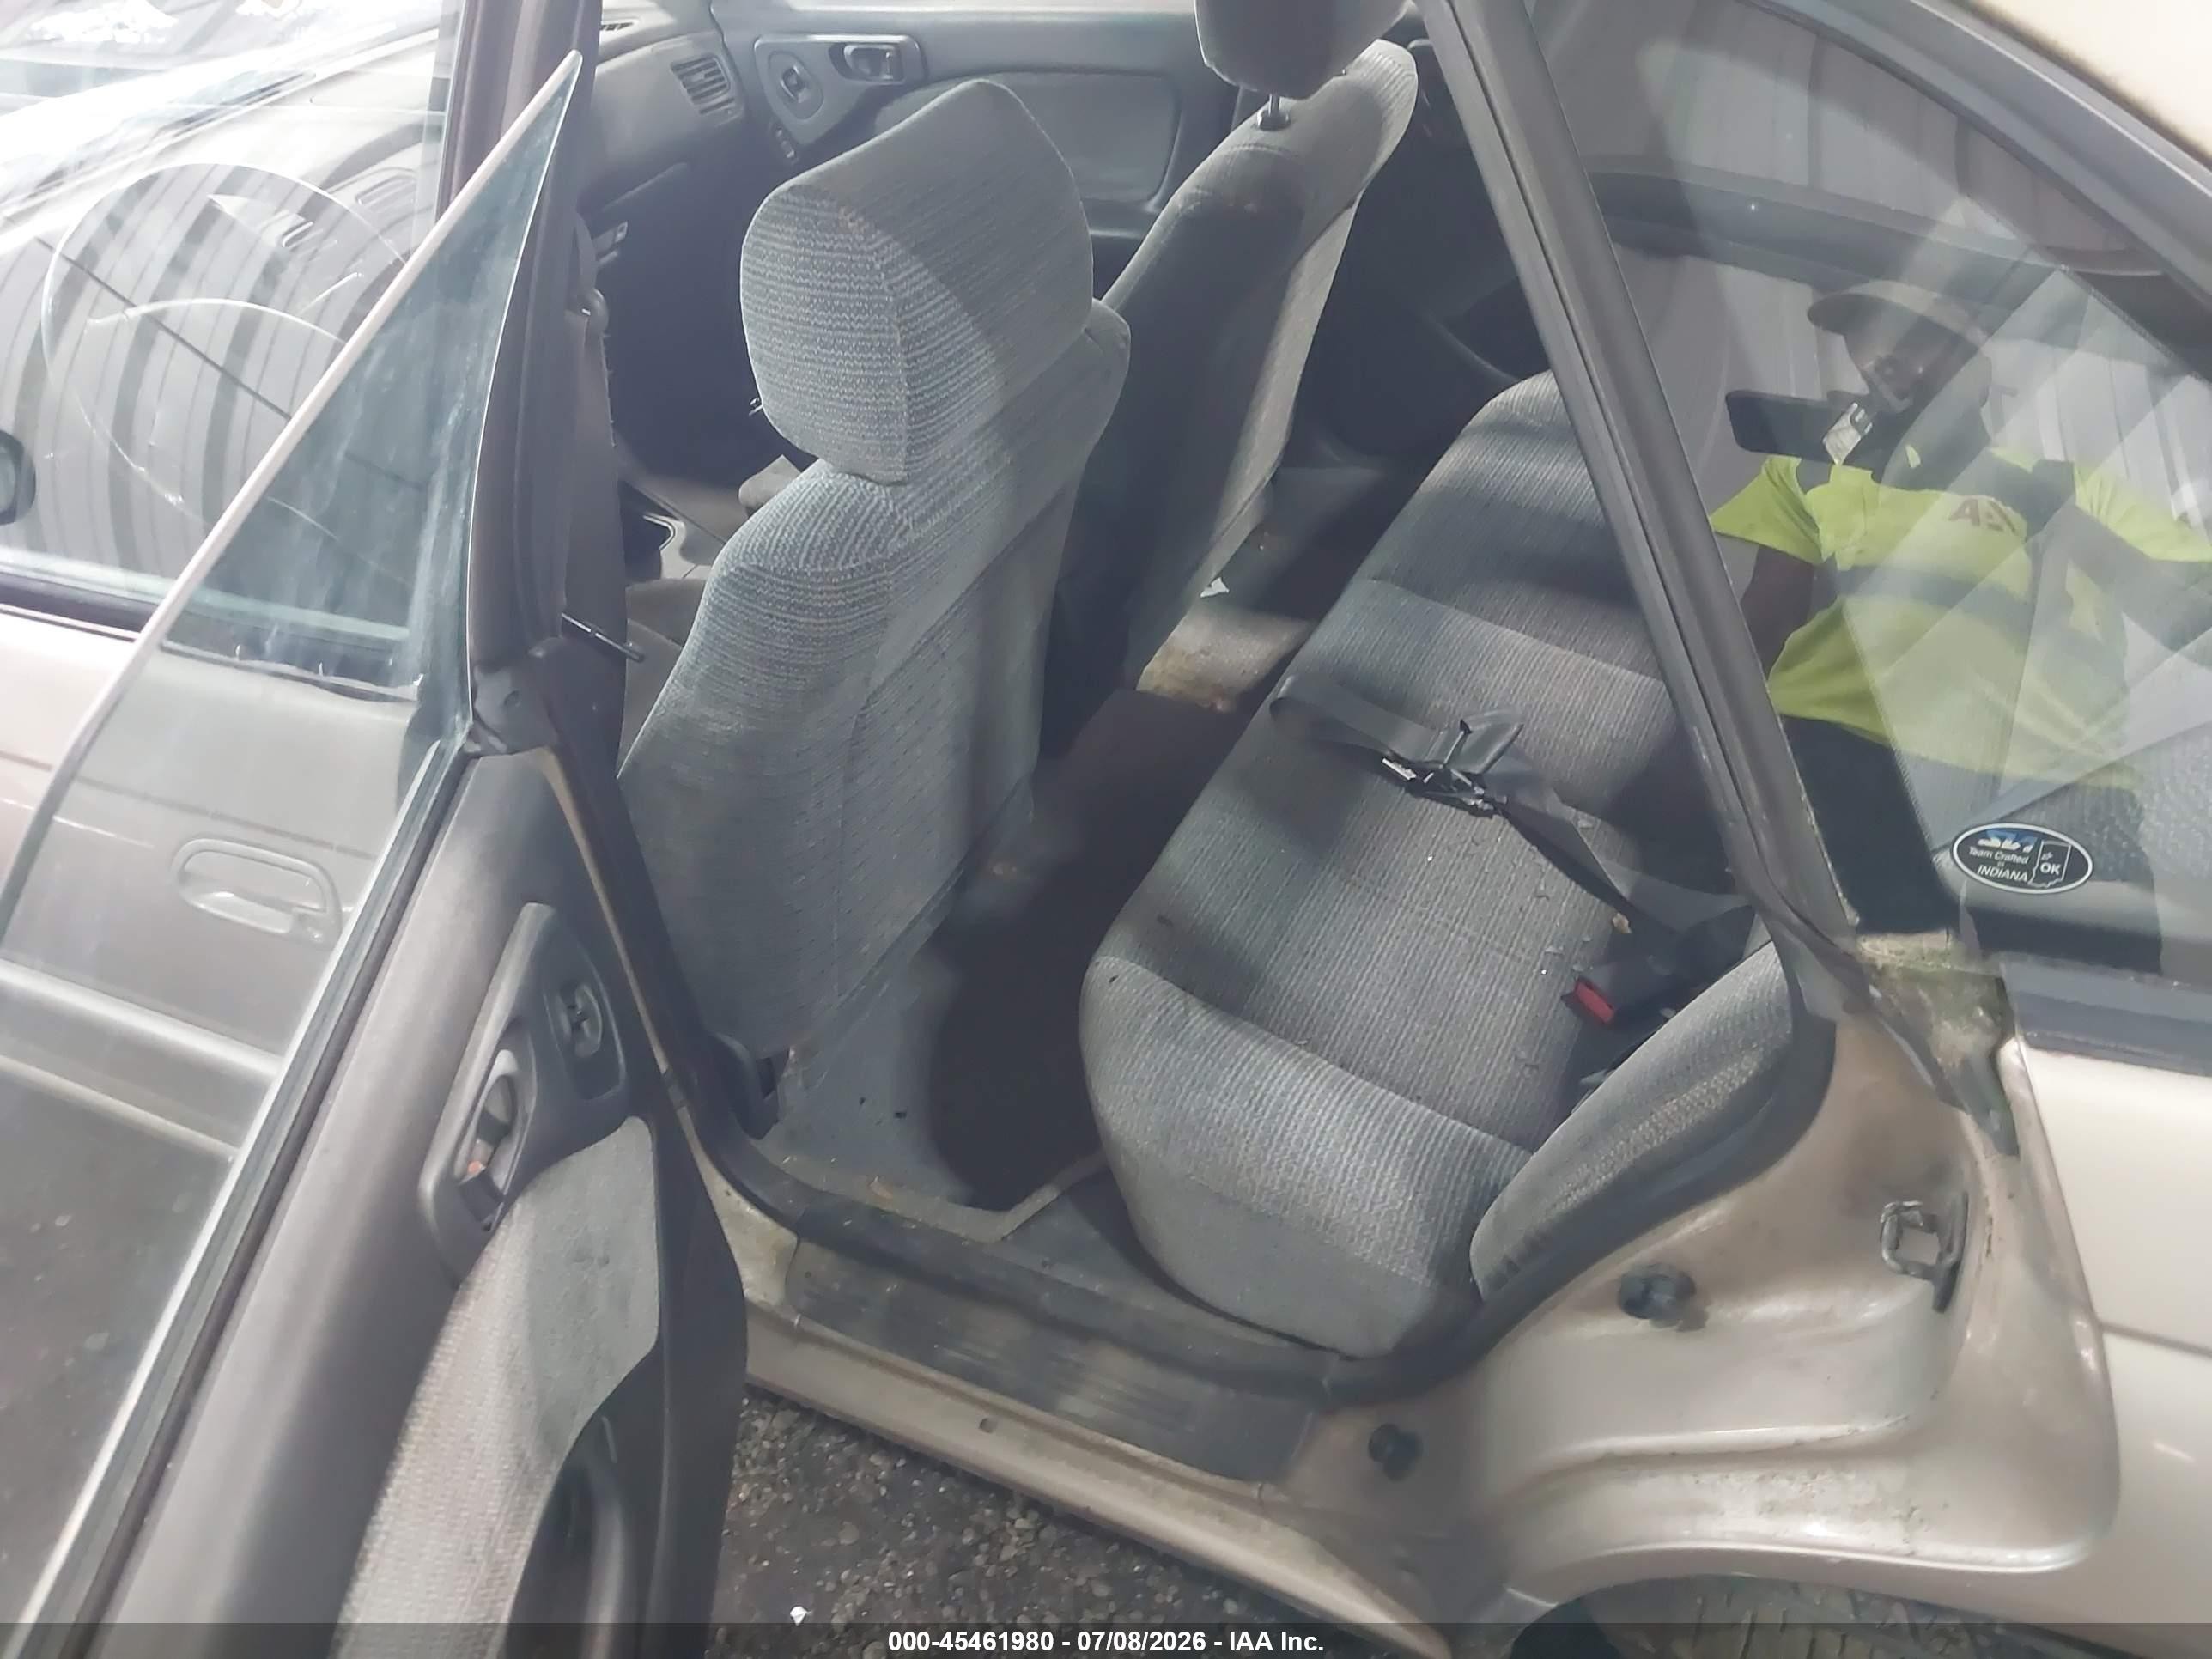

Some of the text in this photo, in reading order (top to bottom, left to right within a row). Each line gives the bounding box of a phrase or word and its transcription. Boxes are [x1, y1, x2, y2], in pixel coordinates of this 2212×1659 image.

[1970, 847, 1992, 859] Team
[1995, 852, 2029, 865] Crafted
[1978, 865, 2027, 881] INDIANA
[2040, 862, 2061, 874] OK
